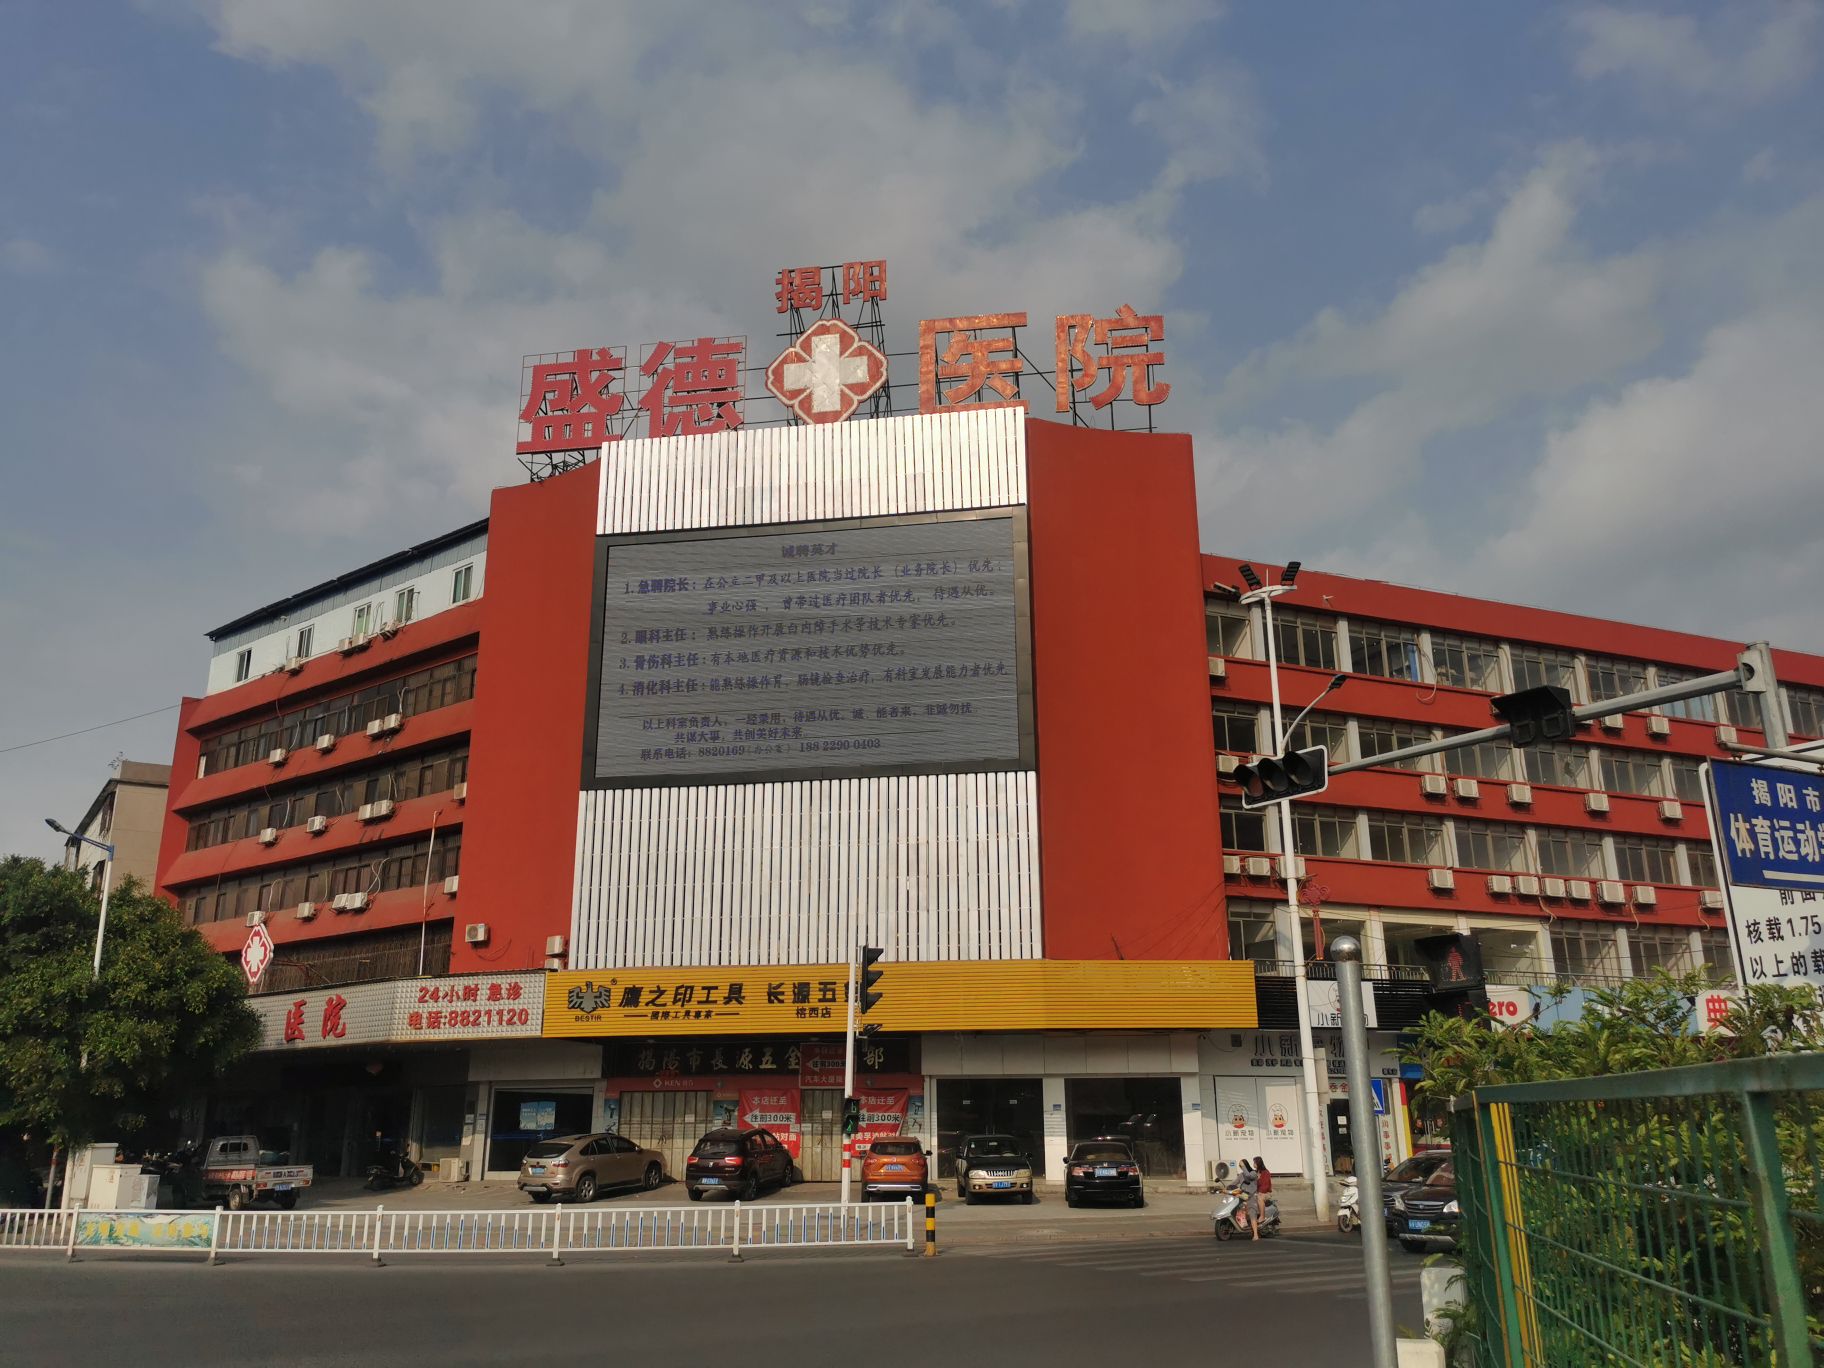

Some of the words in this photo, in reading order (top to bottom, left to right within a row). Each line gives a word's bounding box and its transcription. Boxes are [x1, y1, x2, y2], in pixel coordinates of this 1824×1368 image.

[775, 260, 887, 313] 揭阳
[516, 337, 745, 453] 盛德
[918, 303, 1171, 414] 医院
[781, 542, 839, 558] 诚聘英才
[1750, 778, 1821, 813] 揭阳市
[284, 994, 347, 1043] 医院
